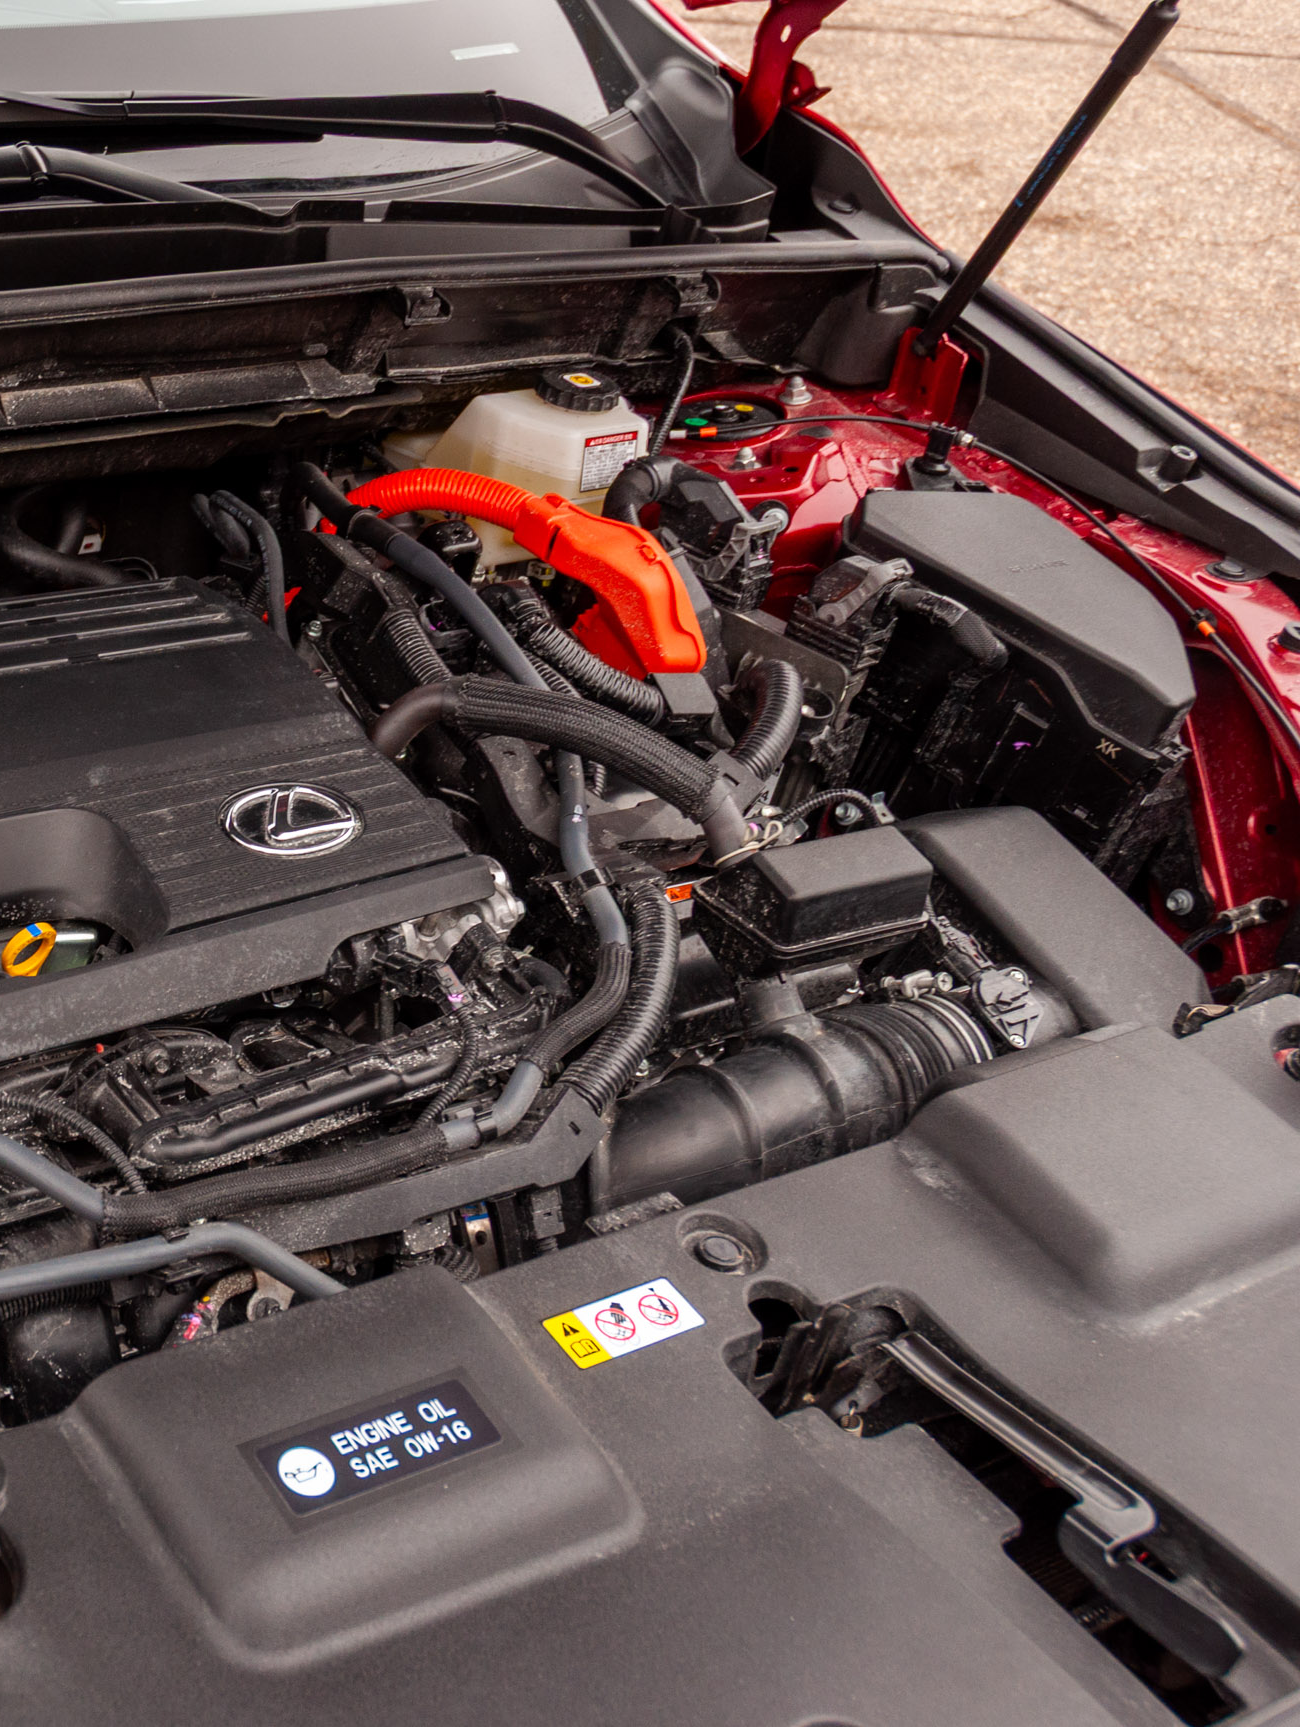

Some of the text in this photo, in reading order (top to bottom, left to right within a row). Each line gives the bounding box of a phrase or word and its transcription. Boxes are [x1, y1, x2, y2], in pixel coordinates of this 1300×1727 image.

[331, 1398, 457, 1455] ENGINE OIL
[350, 1446, 399, 1479] SAE
